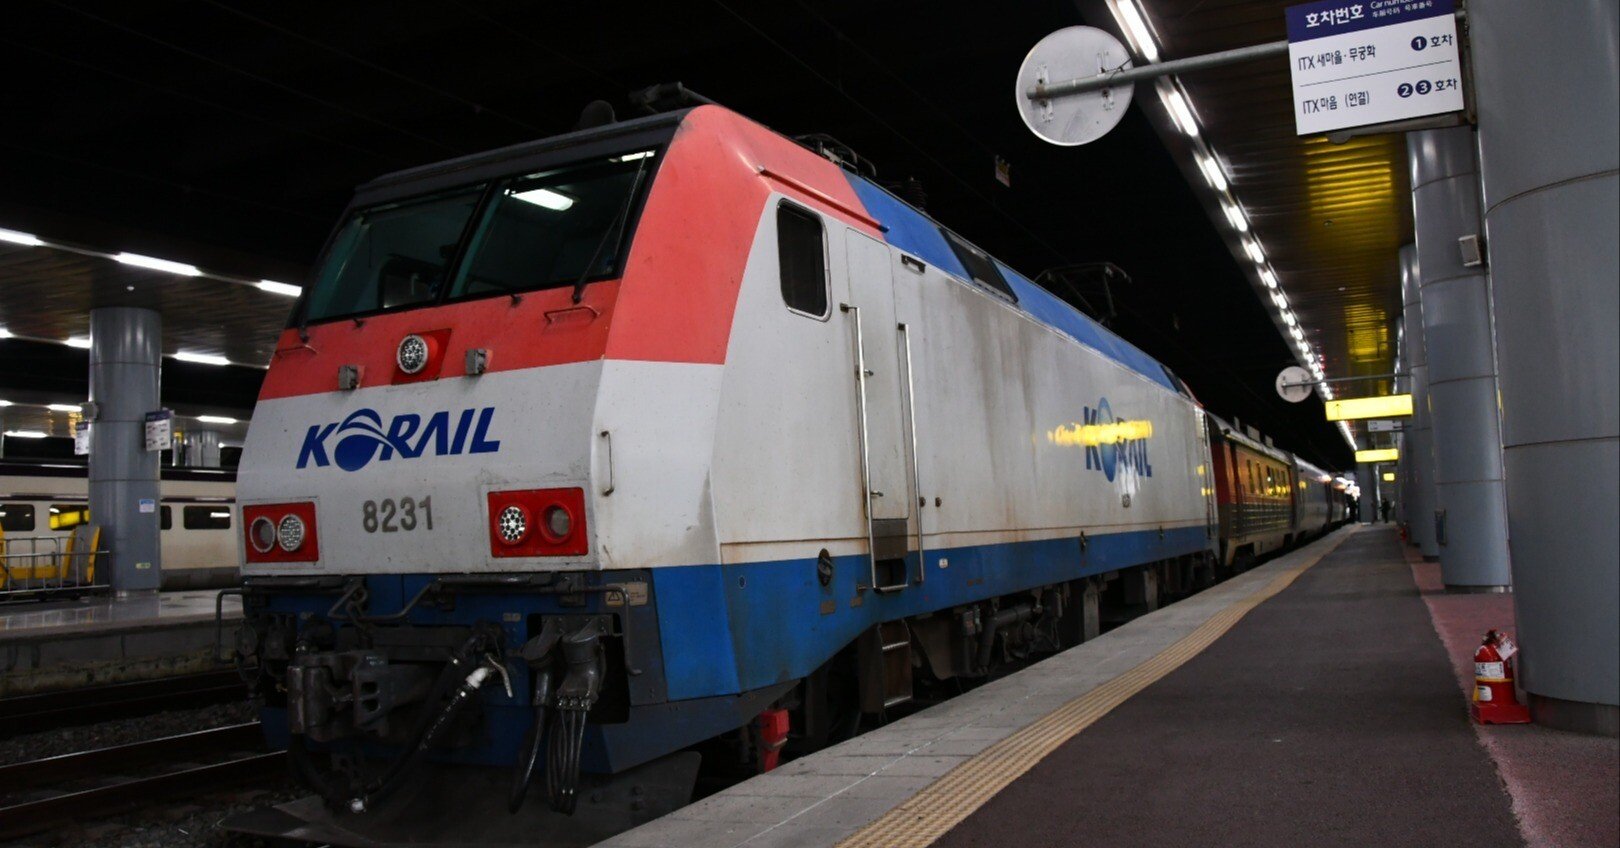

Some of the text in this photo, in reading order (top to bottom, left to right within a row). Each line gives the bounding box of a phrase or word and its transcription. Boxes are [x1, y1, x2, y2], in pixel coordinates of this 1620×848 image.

[1305, 4, 1365, 28] 호차번호
[1298, 57, 1315, 71] ITX
[1430, 33, 1453, 48] 호차
[1302, 100, 1319, 115] ITX
[1320, 95, 1338, 111] 마음
[1344, 90, 1370, 108] (연결)
[1434, 77, 1458, 92] 호차
[296, 407, 501, 472] KORAIL
[362, 495, 434, 533] 8231
